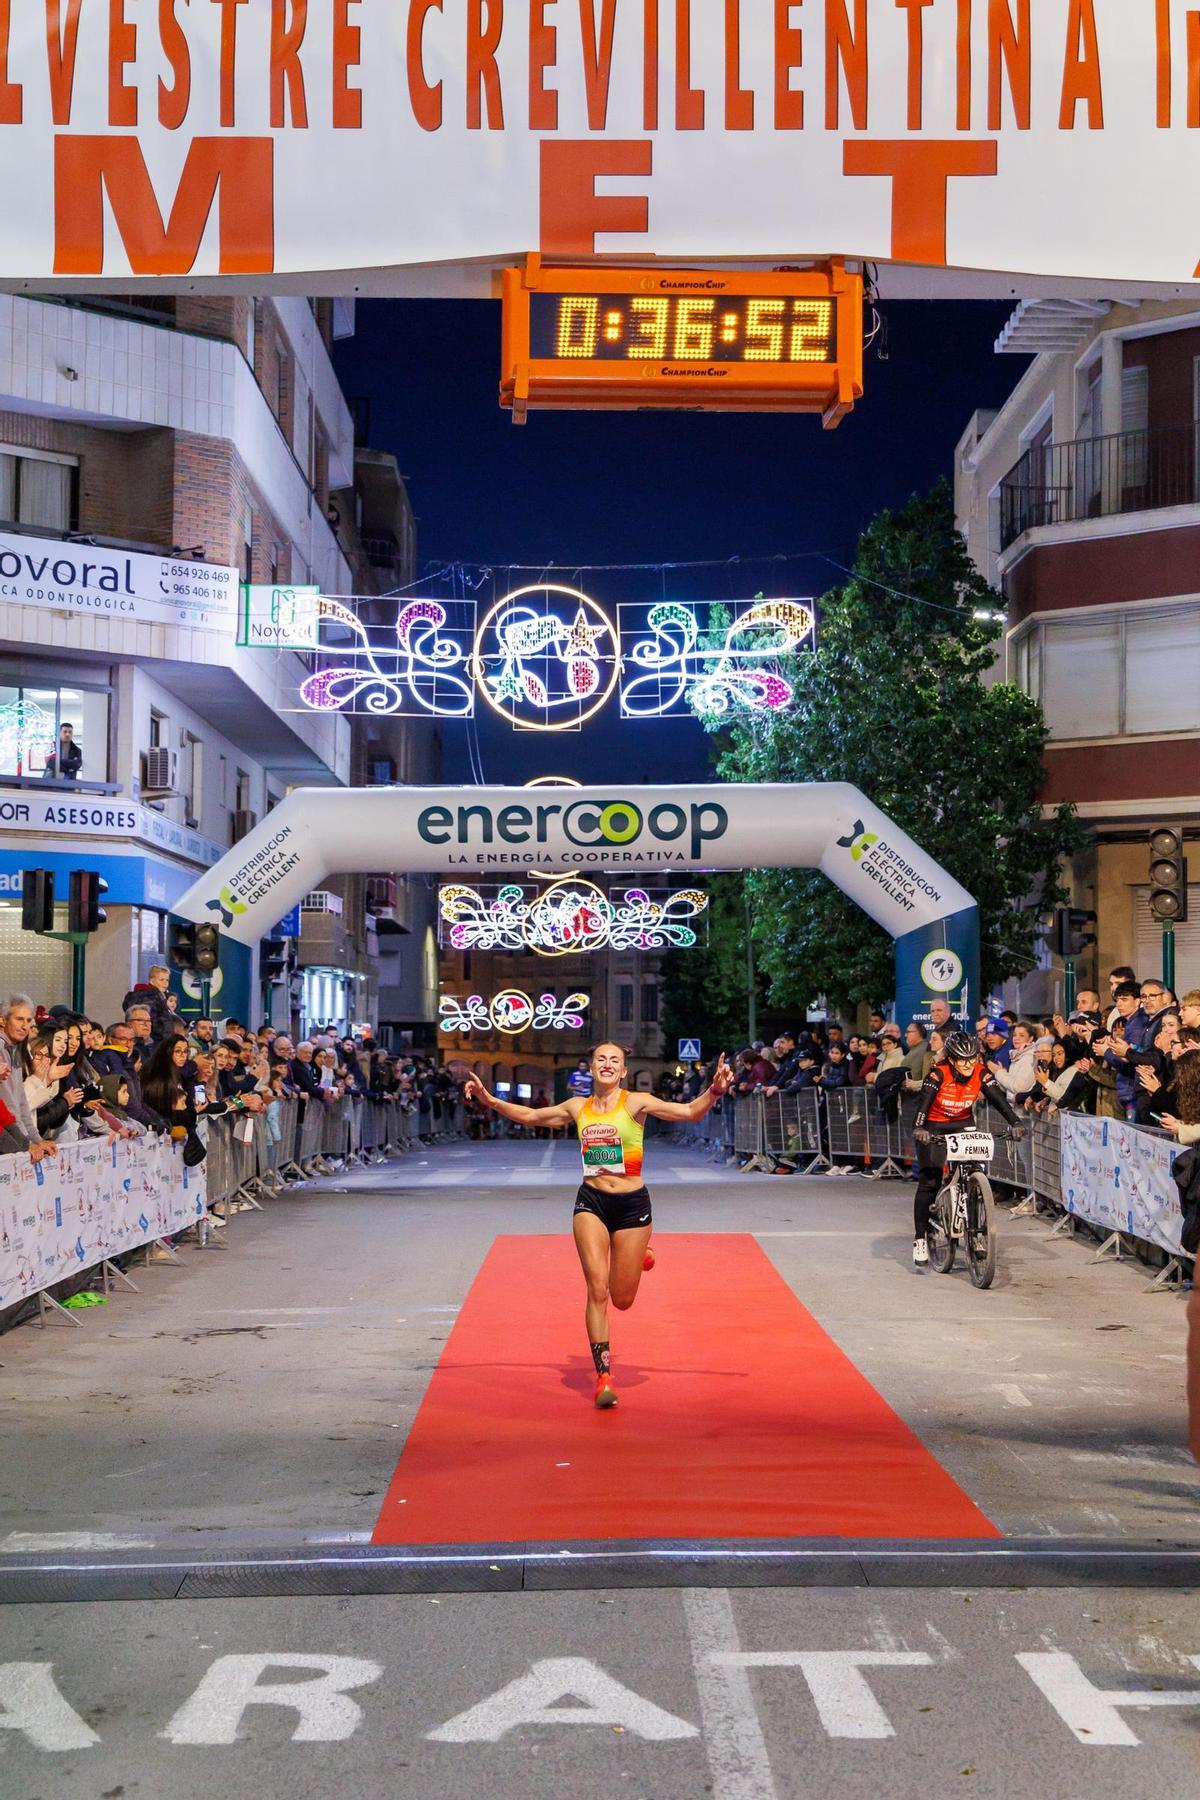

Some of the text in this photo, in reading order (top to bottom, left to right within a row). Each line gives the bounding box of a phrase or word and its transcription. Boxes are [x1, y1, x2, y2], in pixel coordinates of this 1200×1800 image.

[406, 0, 1105, 131] CREVILLENTINA
[556, 297, 831, 361] 0:36:52
[171, 565, 230, 583] 654 926 469
[173, 583, 227, 600] 965 406 181
[26, 587, 135, 612] ODONTOLÓGICA
[44, 806, 137, 828] ASESORES
[417, 800, 728, 860] enercoop
[229, 825, 292, 888] DISTRIBUCIÓN
[238, 851, 287, 897] ELÉCTRICA
[248, 852, 301, 905] CREVILLENT
[448, 850, 686, 864] LA ENERGÍA COOPERATIVA
[869, 850, 916, 898] ELÉCTRICA
[878, 841, 941, 902] DISTRIBUCIÓN
[861, 861, 915, 912] CREVILLENT
[960, 1133, 992, 1141] GENERAL
